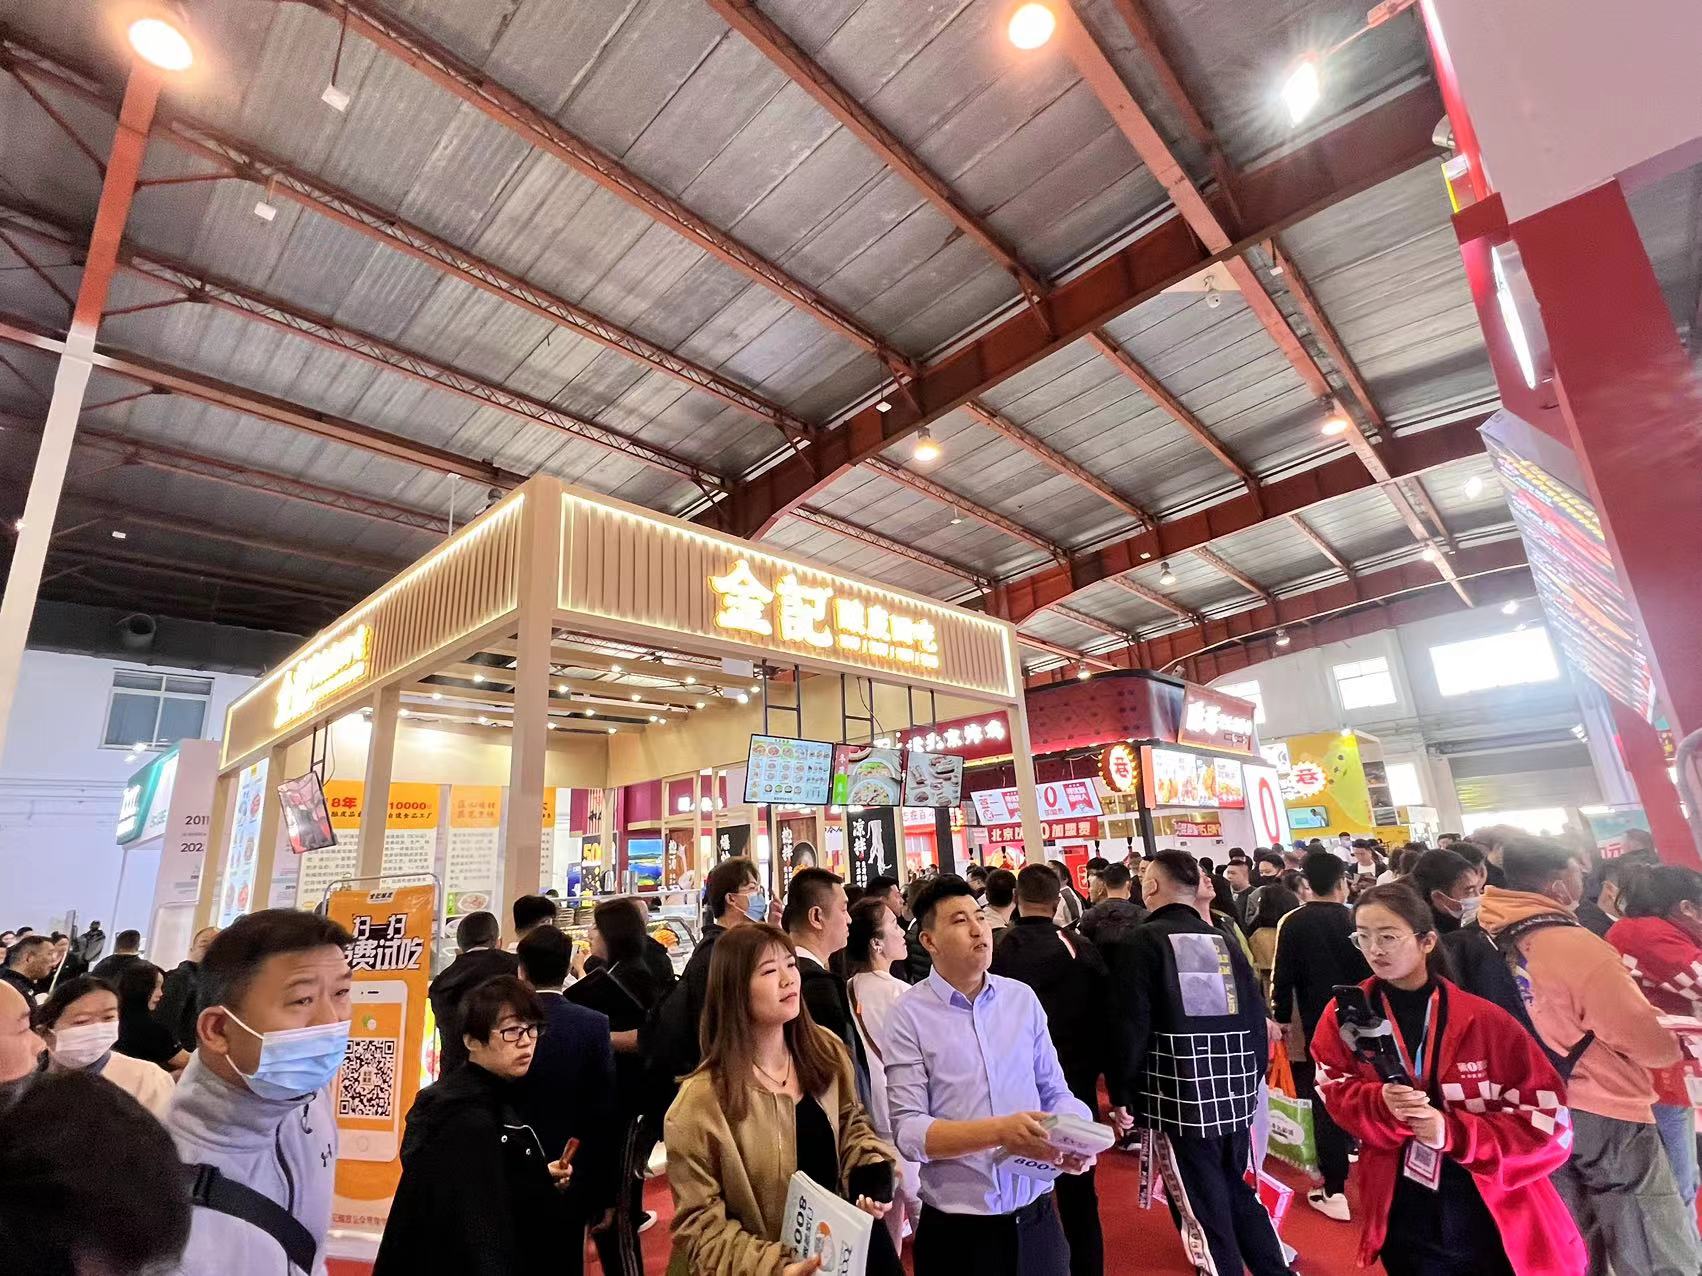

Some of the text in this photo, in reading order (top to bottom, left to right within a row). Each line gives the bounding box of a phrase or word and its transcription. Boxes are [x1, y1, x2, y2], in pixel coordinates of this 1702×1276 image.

[326, 797, 357, 809] 8年
[181, 842, 204, 853] 202
[353, 914, 408, 940] 扫一扫
